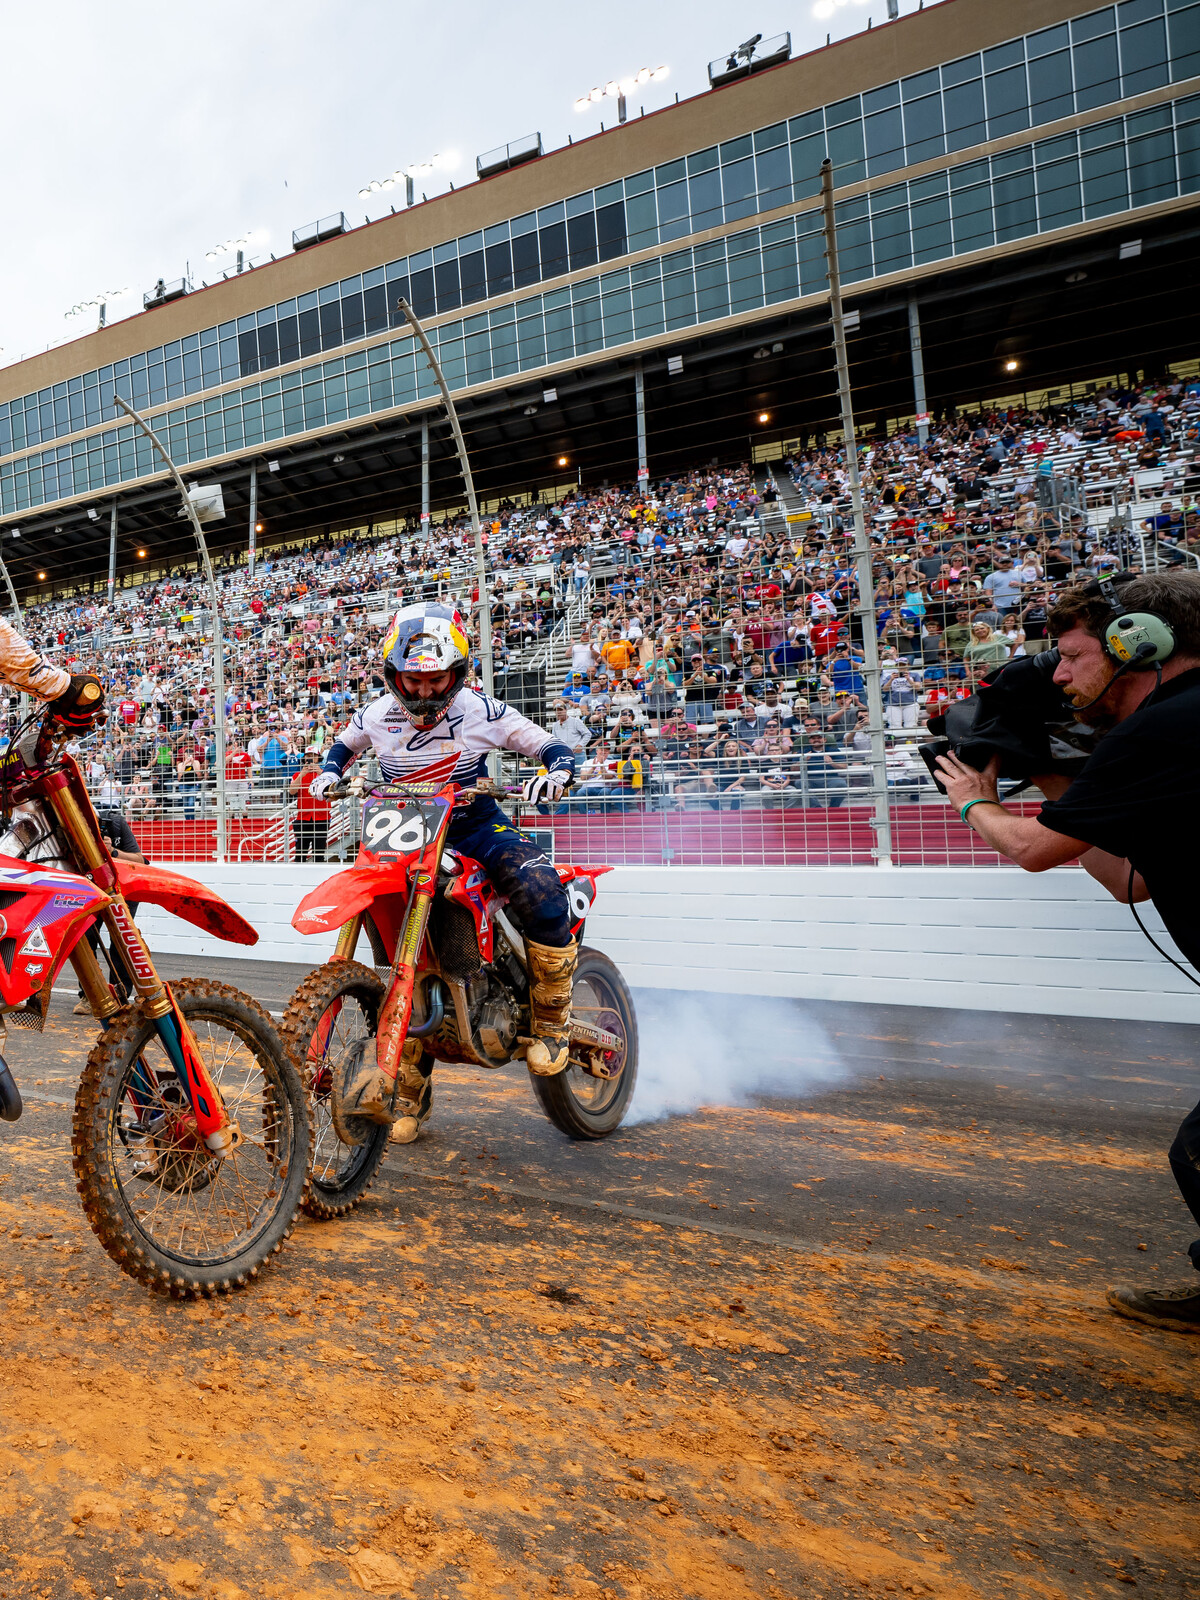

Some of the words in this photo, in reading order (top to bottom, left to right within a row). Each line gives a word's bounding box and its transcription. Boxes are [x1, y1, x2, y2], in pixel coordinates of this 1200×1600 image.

[365, 809, 434, 851] 96
[55, 894, 87, 907] HRC
[567, 882, 590, 919] 6
[109, 903, 154, 979] SHOWA
[573, 1025, 598, 1039] ENTHAL
